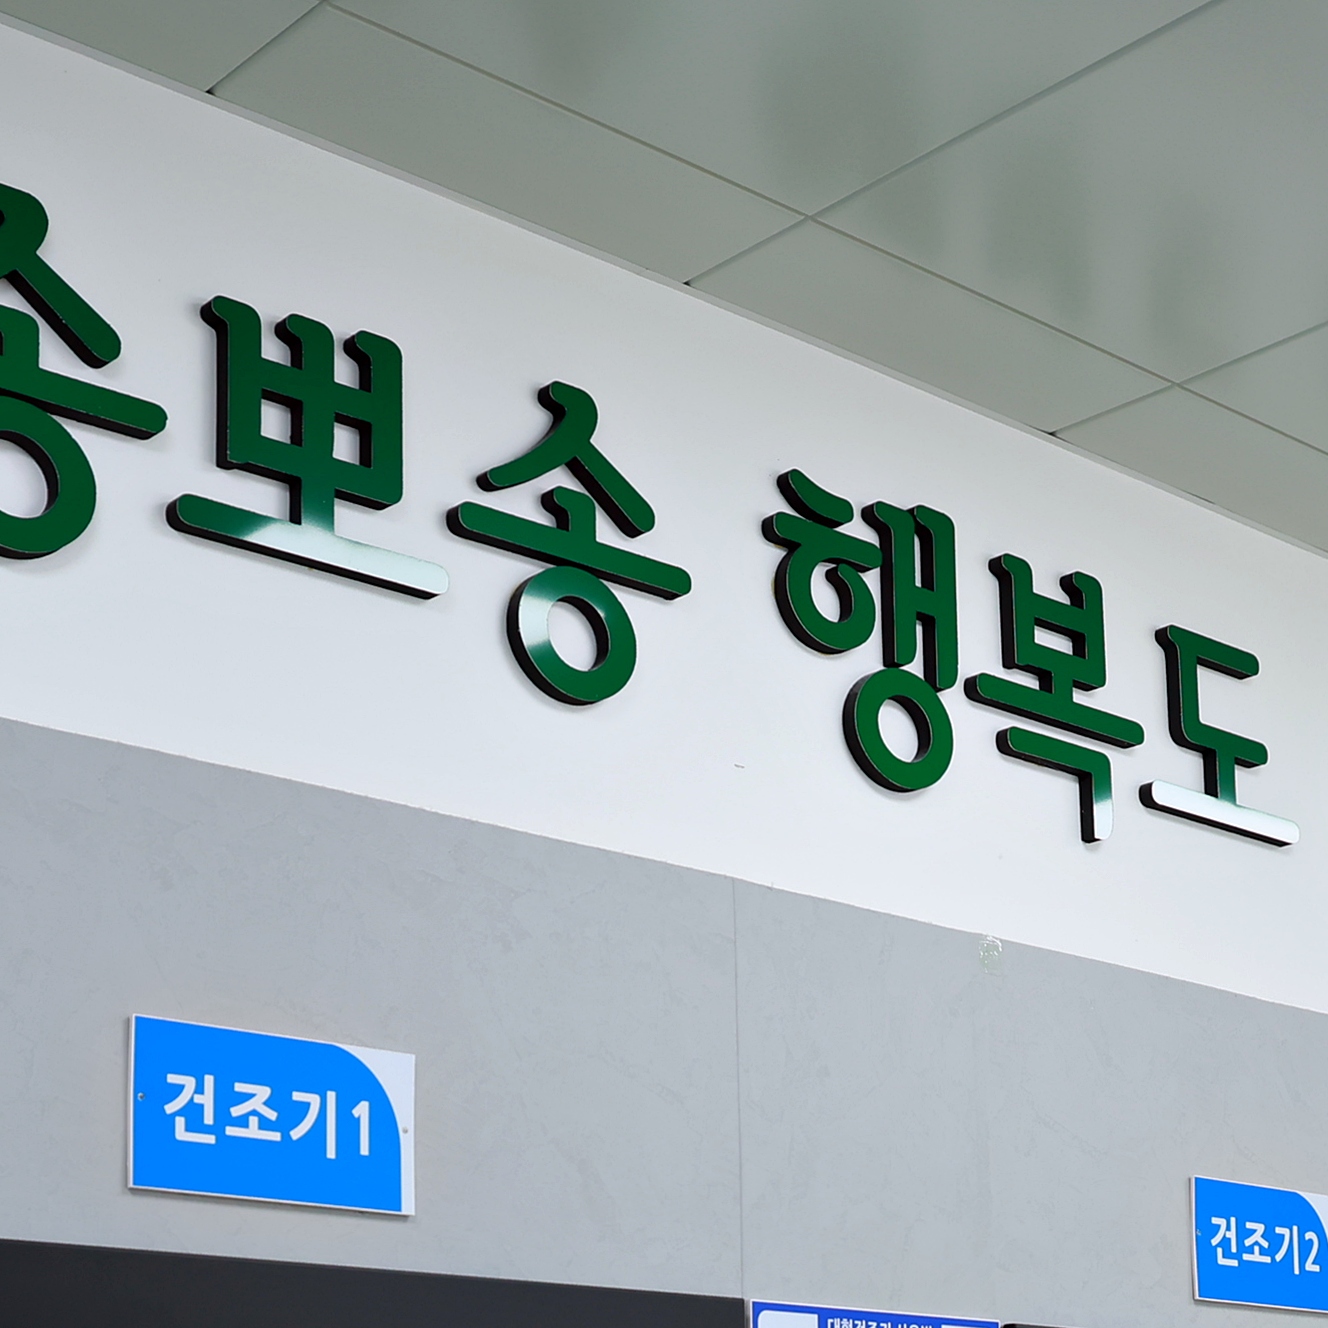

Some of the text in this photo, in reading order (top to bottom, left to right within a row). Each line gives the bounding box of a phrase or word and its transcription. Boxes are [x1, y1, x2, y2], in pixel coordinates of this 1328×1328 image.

[762, 468, 1301, 847] 행복도
[164, 1073, 370, 1159] 건조기1
[1211, 1216, 1320, 1274] 건조기2
